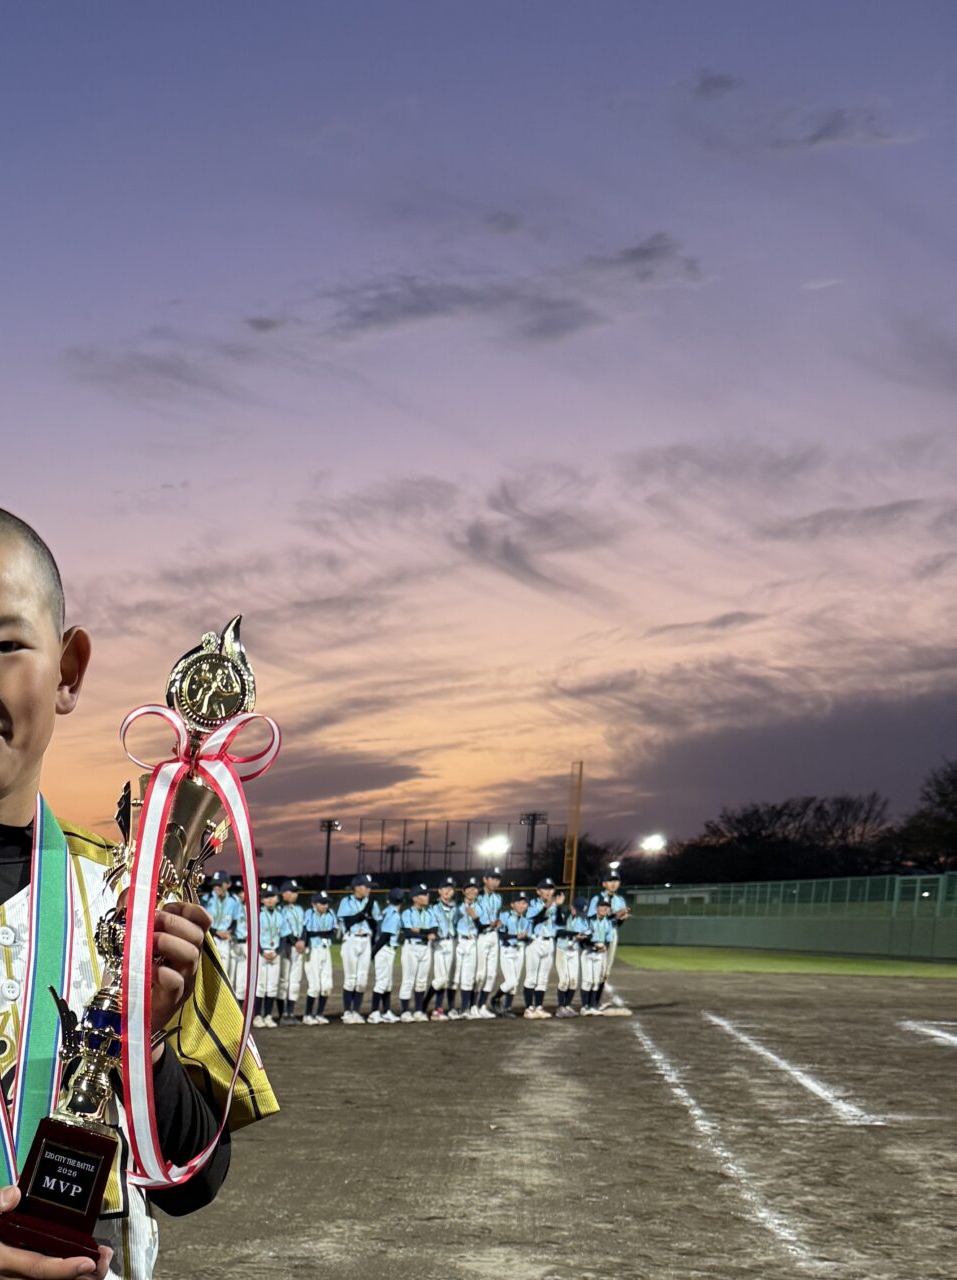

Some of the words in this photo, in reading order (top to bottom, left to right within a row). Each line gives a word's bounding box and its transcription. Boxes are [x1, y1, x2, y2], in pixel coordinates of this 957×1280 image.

[44, 1151, 55, 1160] EZO
[55, 1154, 67, 1164] CITY
[66, 1157, 77, 1167] THE
[76, 1161, 95, 1172] BATTLE
[57, 1166, 77, 1177] 2026
[42, 1175, 82, 1196] MVP
